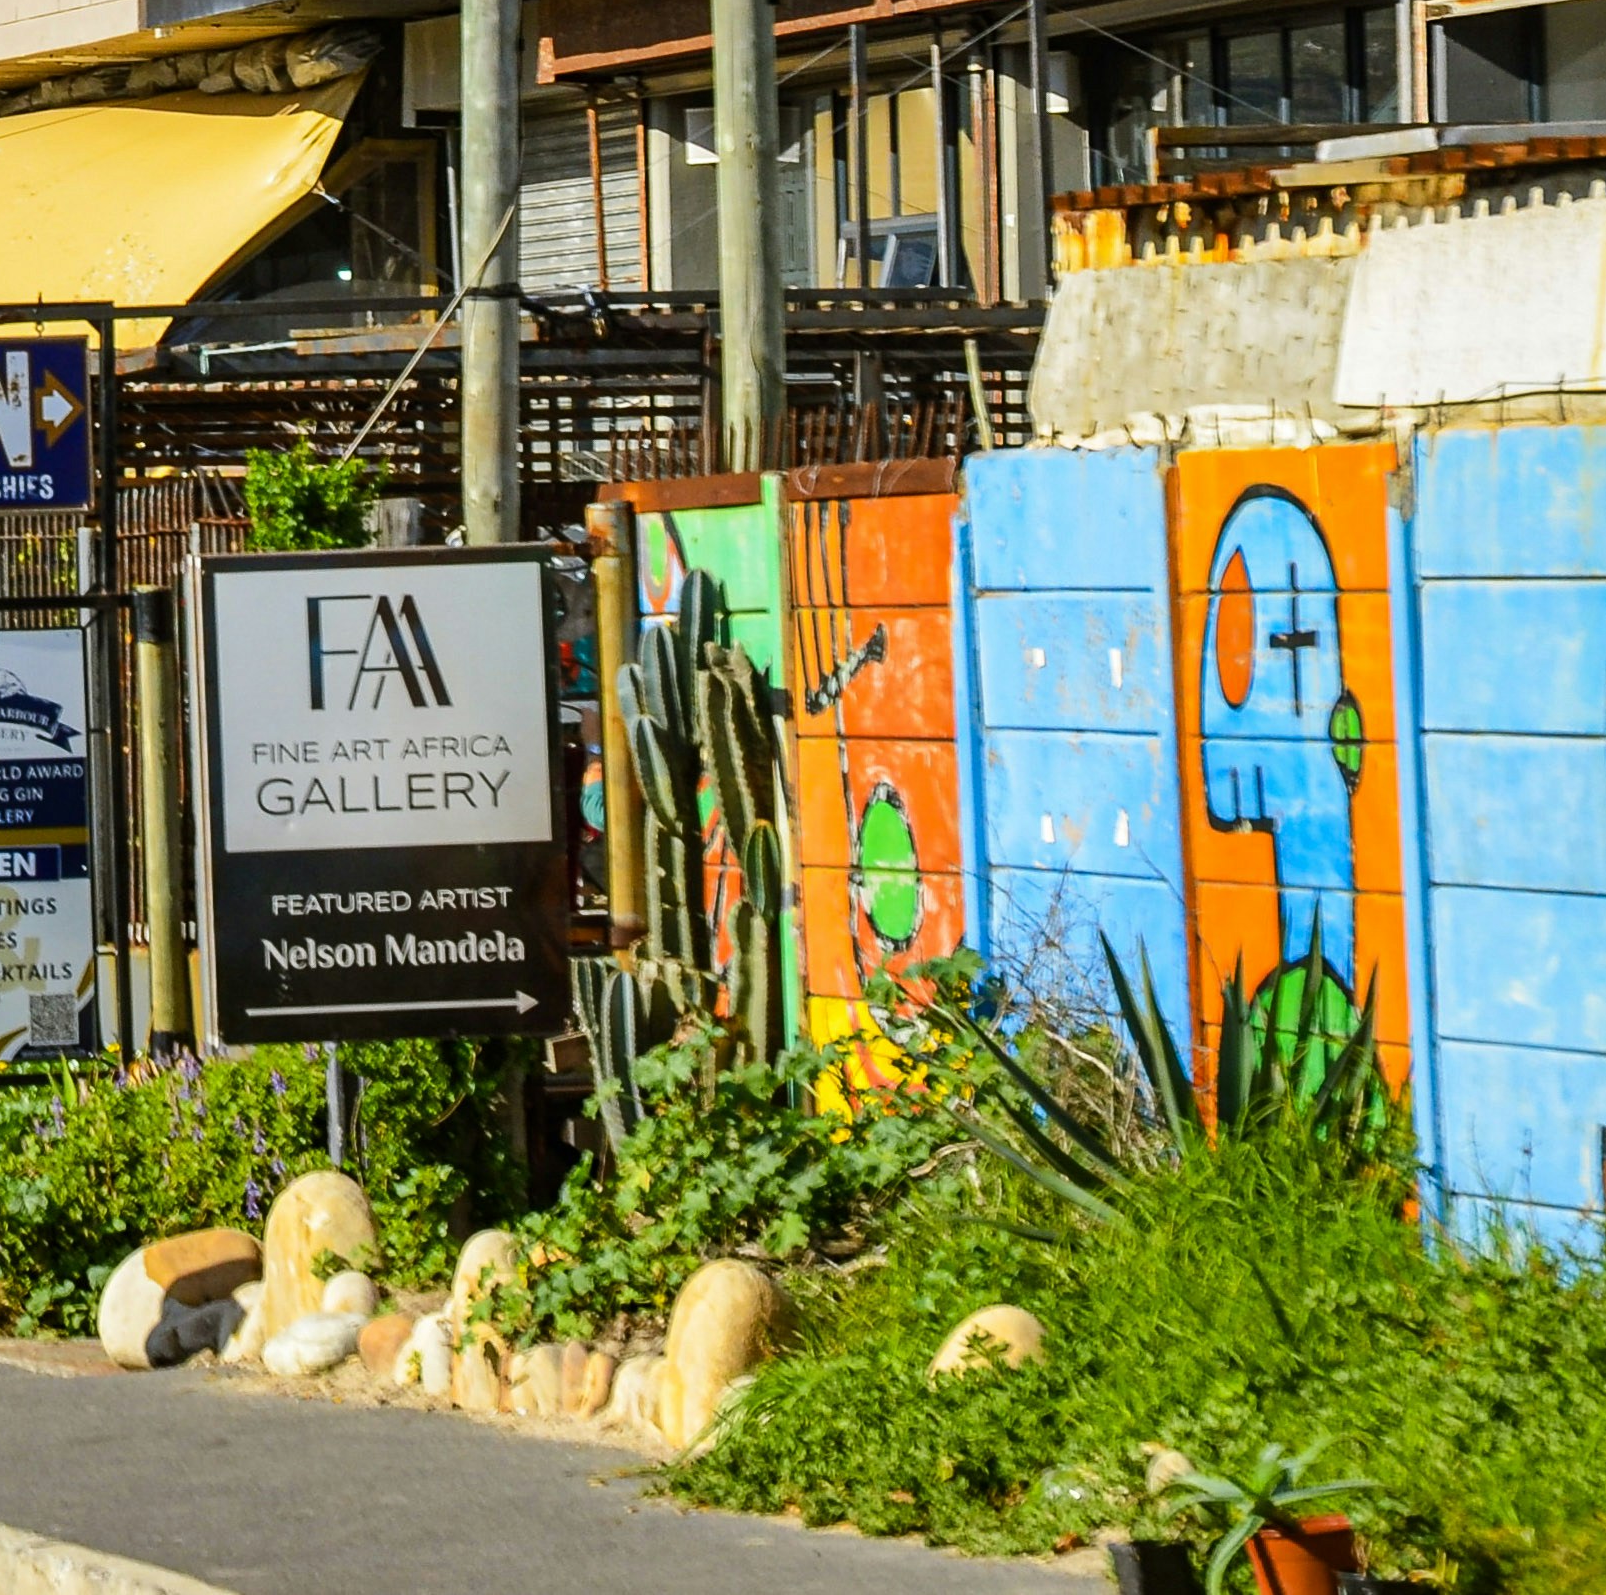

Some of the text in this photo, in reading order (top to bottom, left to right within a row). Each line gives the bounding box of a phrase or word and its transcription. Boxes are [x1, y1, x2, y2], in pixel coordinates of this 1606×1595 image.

[252, 734, 513, 764] FINE ART AFRICA
[26, 764, 85, 779] AWARD
[14, 786, 43, 802] GIN
[256, 770, 511, 816] GALLERY
[271, 886, 513, 916] FEATURED ARTIST
[261, 929, 526, 971] Nelson Mandela
